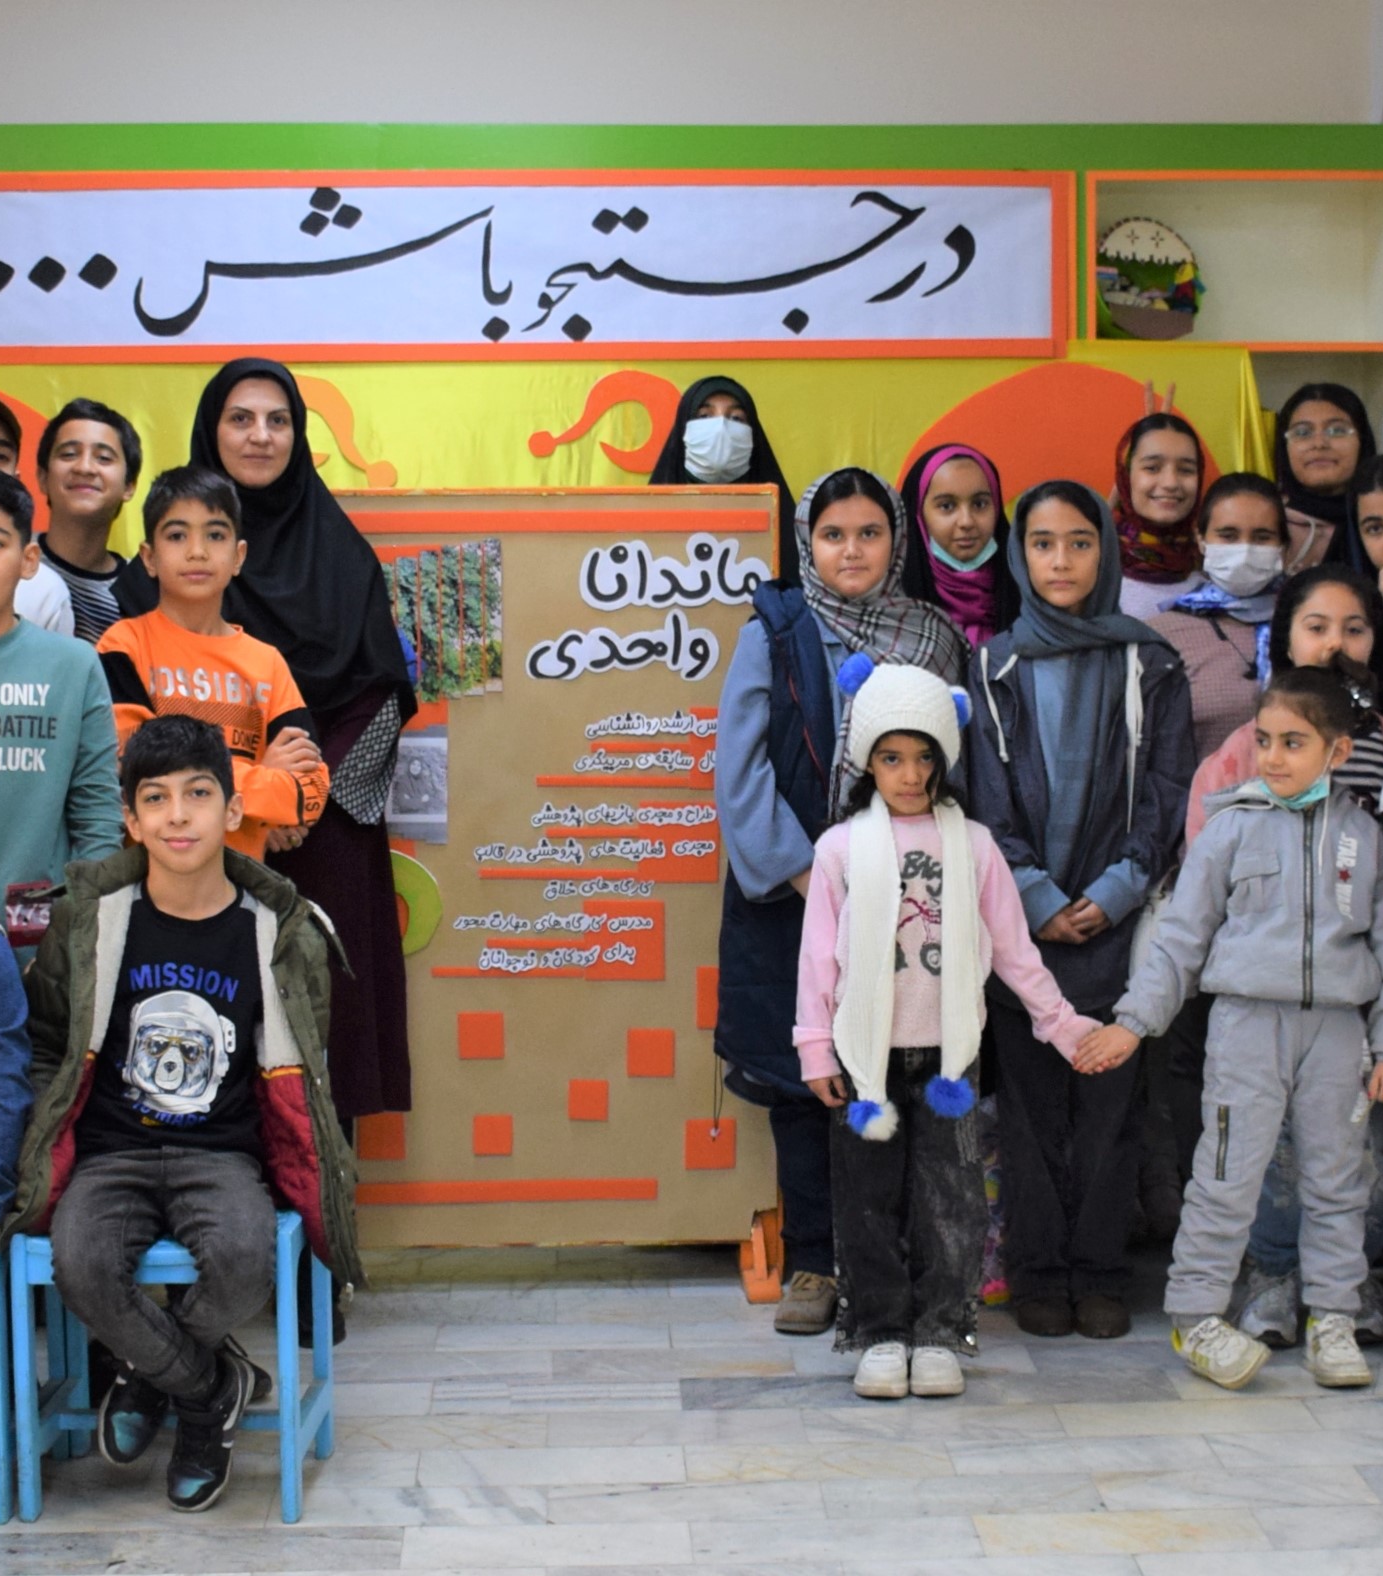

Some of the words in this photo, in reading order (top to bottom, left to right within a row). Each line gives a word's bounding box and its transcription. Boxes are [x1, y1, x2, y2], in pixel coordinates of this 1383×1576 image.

[524, 190, 927, 343] جستجو
[865, 224, 976, 304] در
[586, 543, 761, 602] ماندانا
[529, 613, 710, 678] واحدی
[0, 682, 51, 706] ONLY
[662, 711, 694, 730] ارشد
[232, 728, 261, 750] DONE
[532, 804, 582, 827] پژوهشی
[638, 809, 674, 823] مجری
[676, 811, 684, 822] و
[685, 808, 714, 822] طراح
[508, 848, 523, 860] در
[527, 839, 583, 863] پژوهشی
[674, 841, 714, 856] مجری
[1336, 831, 1358, 868] STAR
[544, 881, 576, 899] خلاق
[455, 919, 487, 930] محور
[490, 914, 529, 933] مهارت
[608, 919, 652, 931] مدرس
[480, 950, 536, 972] نوجوانان
[540, 957, 549, 967] و
[552, 948, 598, 967] کودکان
[604, 944, 636, 962] برای
[129, 962, 239, 1003] MISSION
